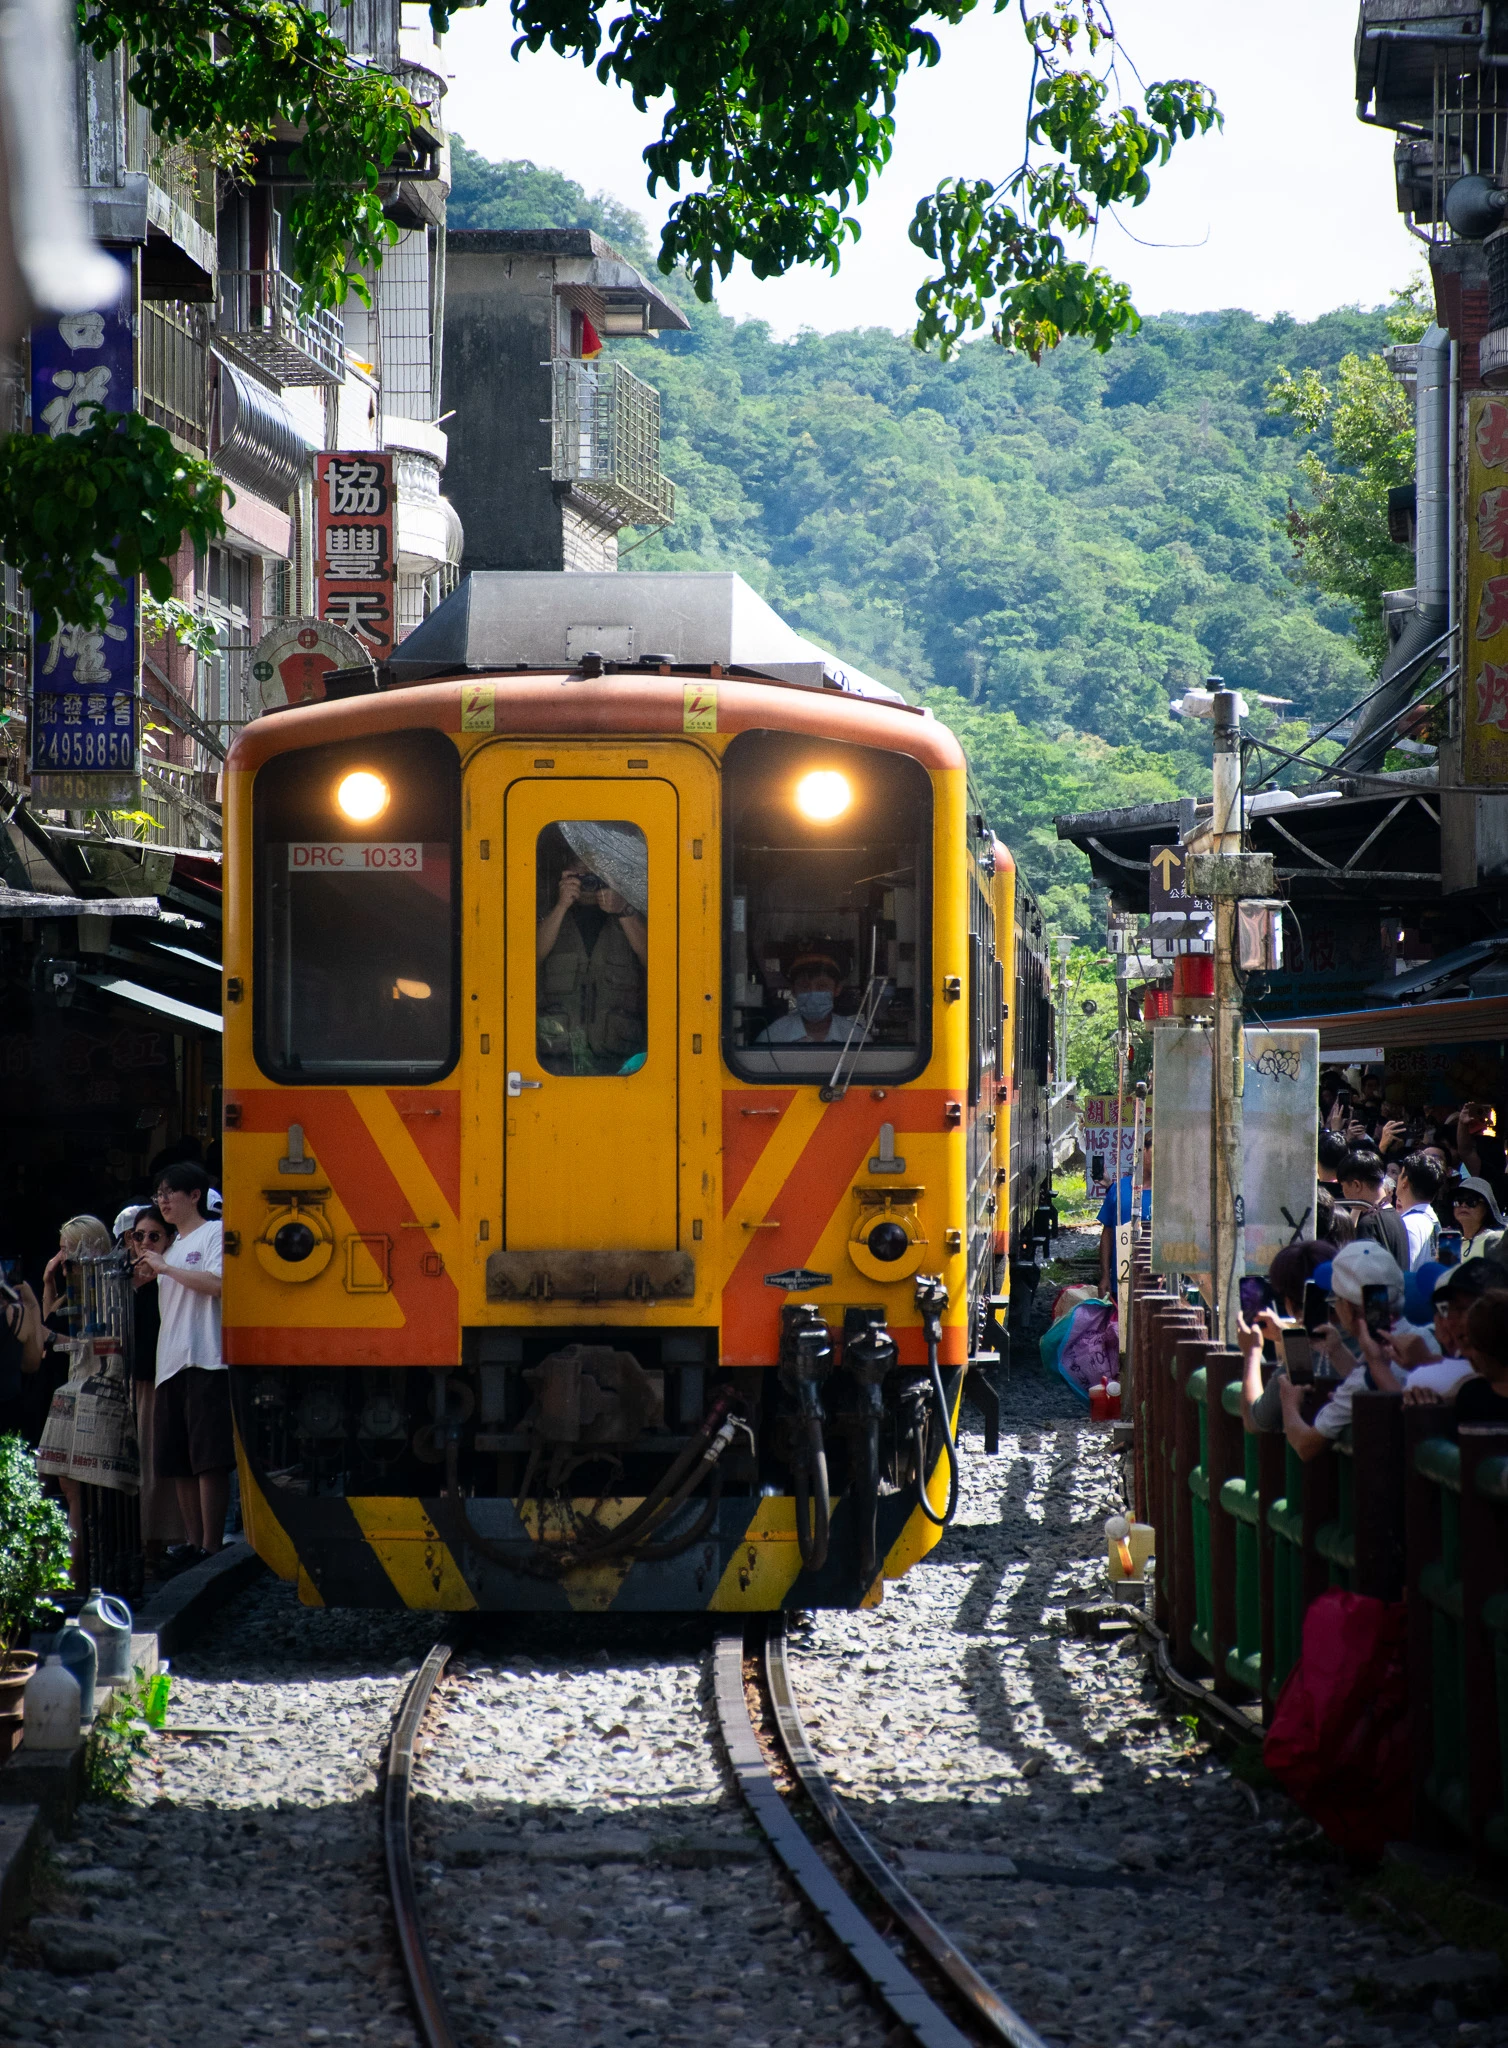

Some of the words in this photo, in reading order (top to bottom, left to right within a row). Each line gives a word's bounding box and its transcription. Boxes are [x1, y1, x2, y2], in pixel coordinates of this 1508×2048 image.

[323, 461, 388, 646] 協豐天
[39, 691, 131, 726] 批發零售
[37, 731, 131, 767] 24958850
[293, 846, 344, 867] DRC
[361, 847, 418, 867] 1033
[1120, 1232, 1129, 1246] 6
[1120, 1259, 1130, 1280] 2
